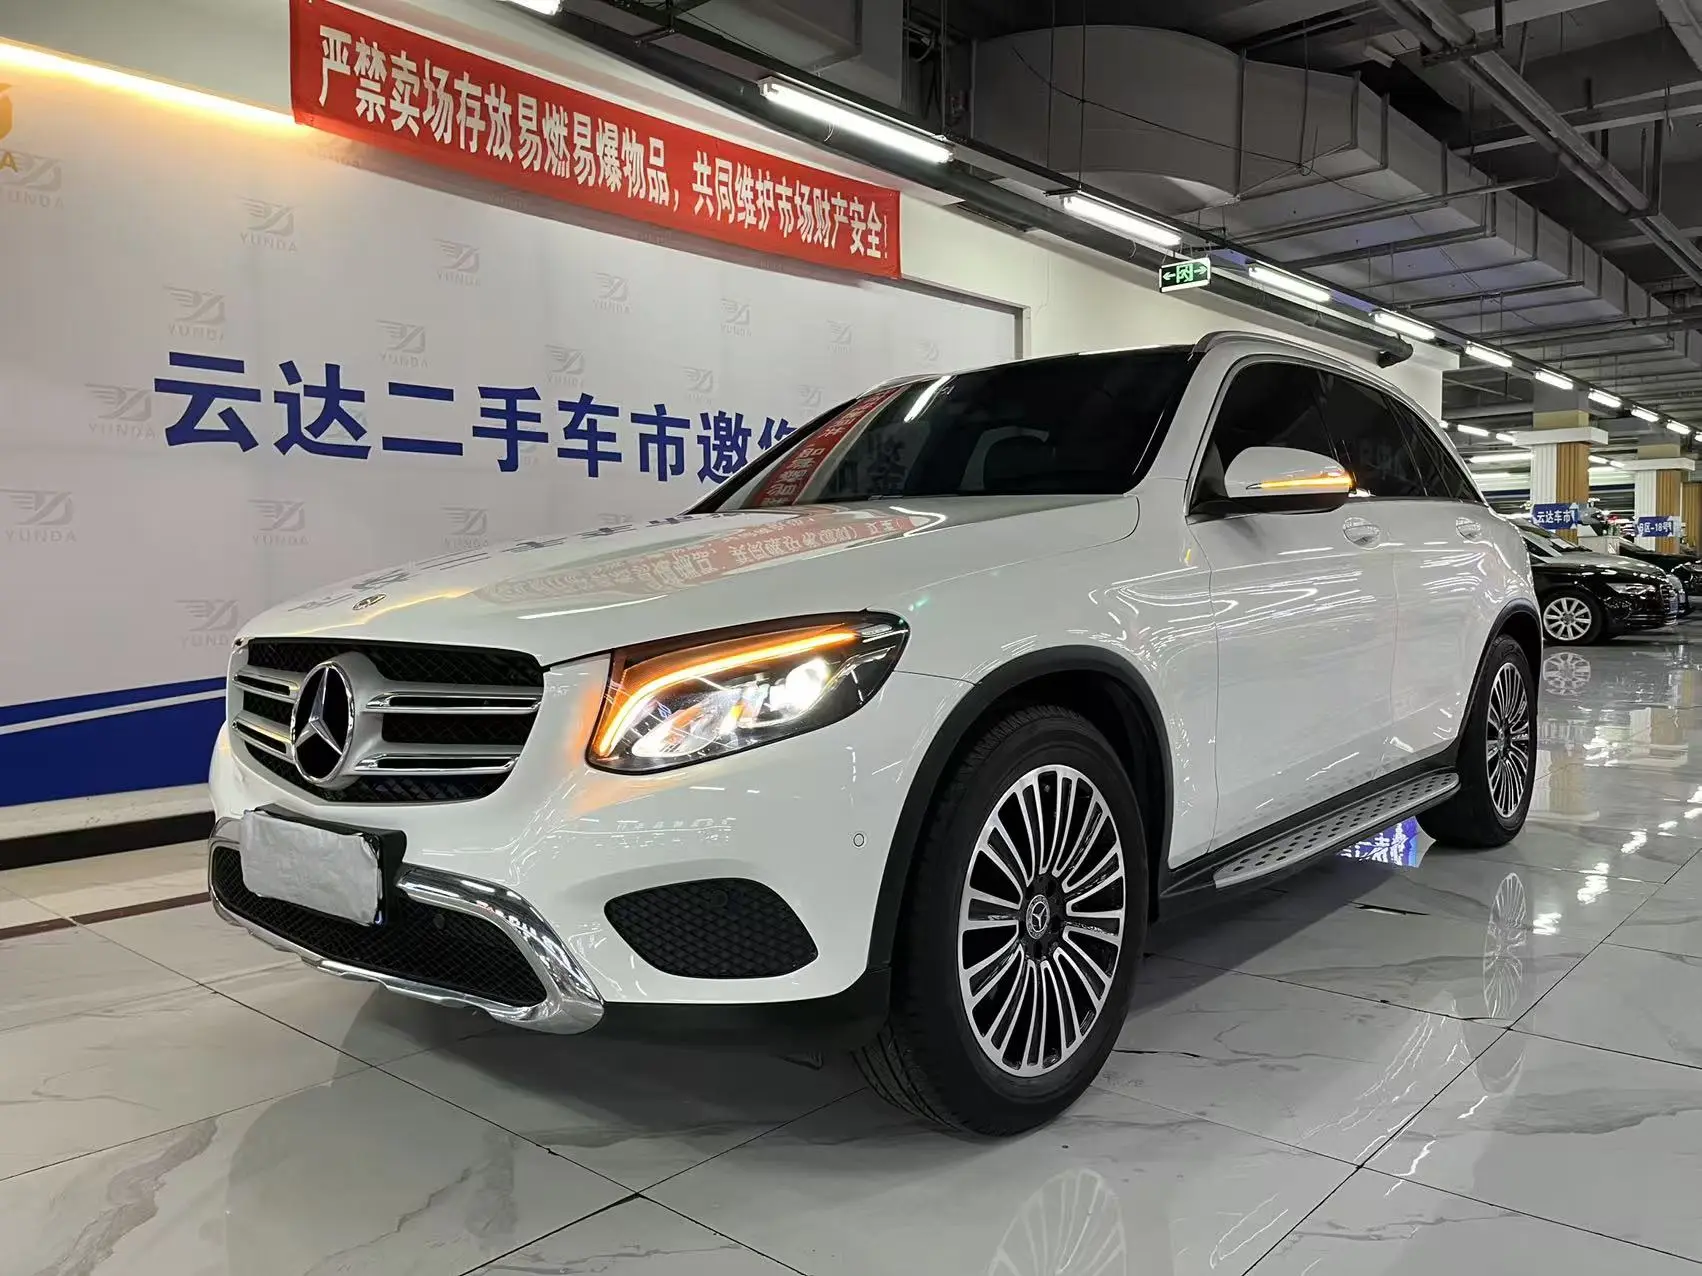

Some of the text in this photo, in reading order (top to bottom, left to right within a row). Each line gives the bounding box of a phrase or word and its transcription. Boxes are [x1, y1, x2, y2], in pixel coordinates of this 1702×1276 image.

[1536, 509, 1572, 524] 云达车市
[5, 528, 78, 544] YUNDA
[181, 632, 233, 650] YUND
